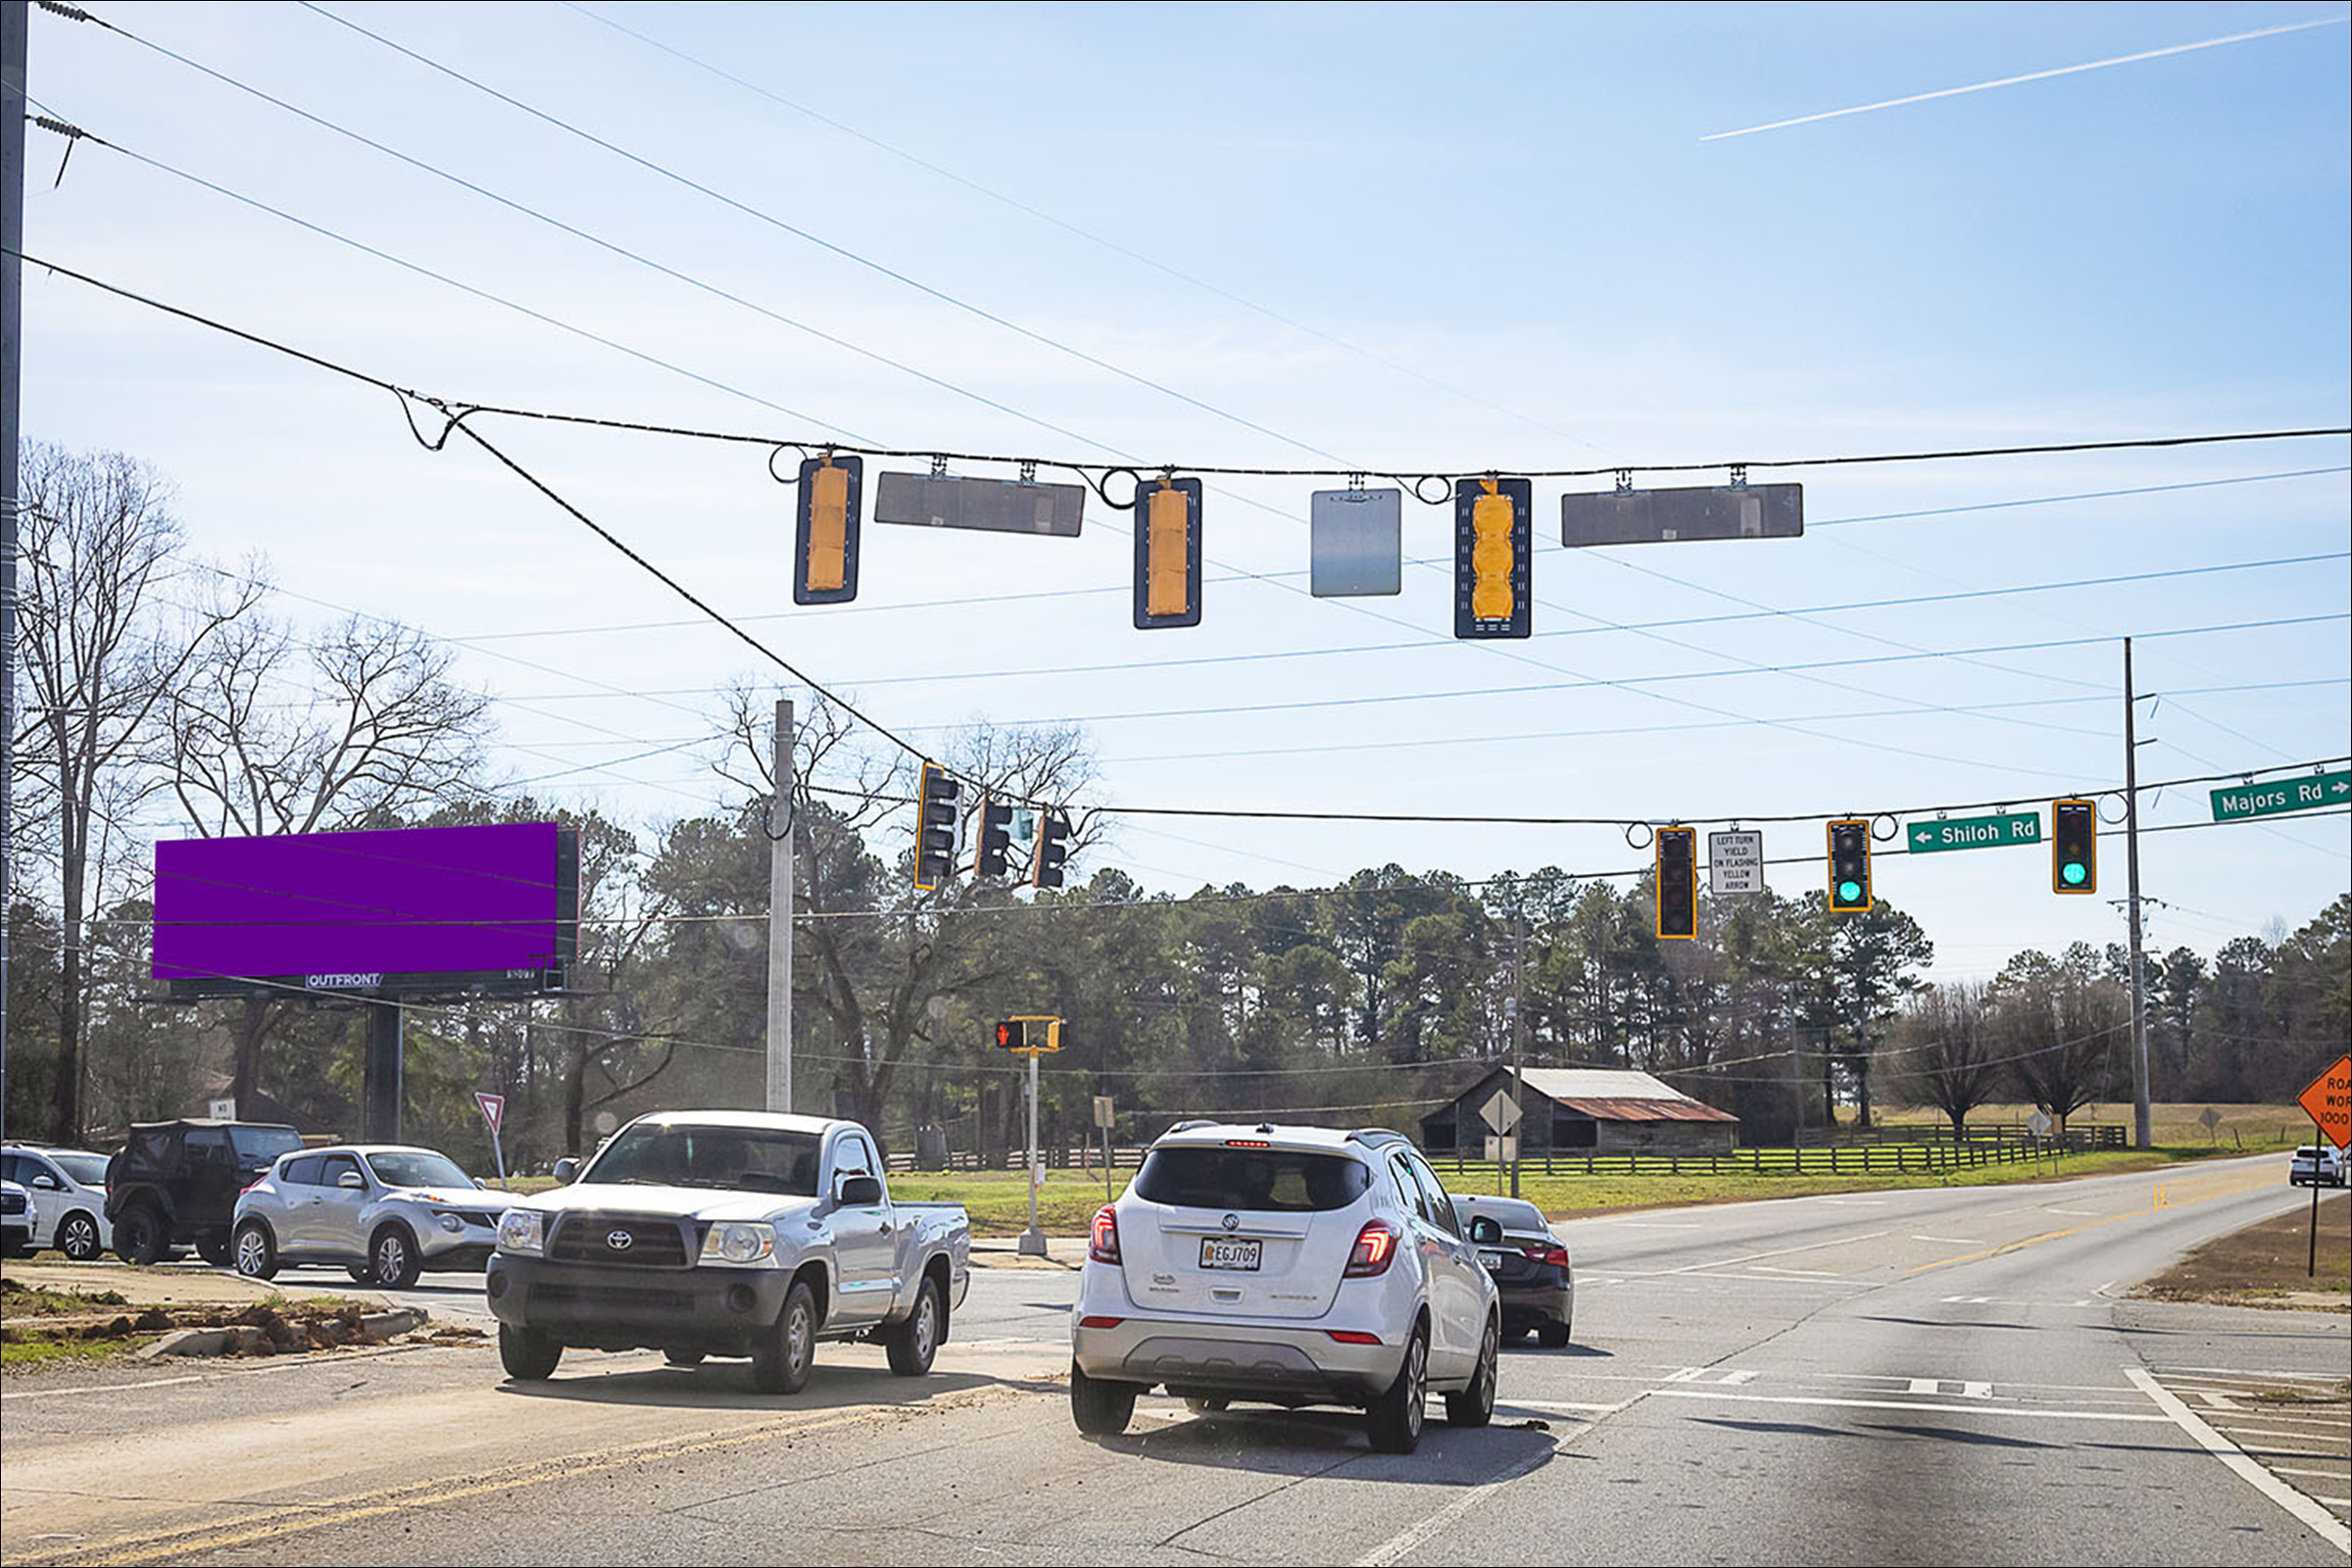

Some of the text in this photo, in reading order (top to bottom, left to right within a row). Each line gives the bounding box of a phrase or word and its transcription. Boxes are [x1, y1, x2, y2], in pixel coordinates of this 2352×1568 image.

[2222, 783, 2323, 814] Majors Rd
[1941, 820, 2035, 844] Shiloh Rd
[1716, 835, 1754, 846] LEFT TURN
[1724, 846, 1748, 857] YIELD
[1713, 858, 1758, 868] ON FLASHING
[1723, 869, 1750, 879] YELLOW
[1725, 881, 1749, 890] ARROW
[309, 972, 379, 987] OUTFRONT
[2320, 1110, 2349, 1126] 1000
[1215, 1246, 1257, 1262] EGJ709
